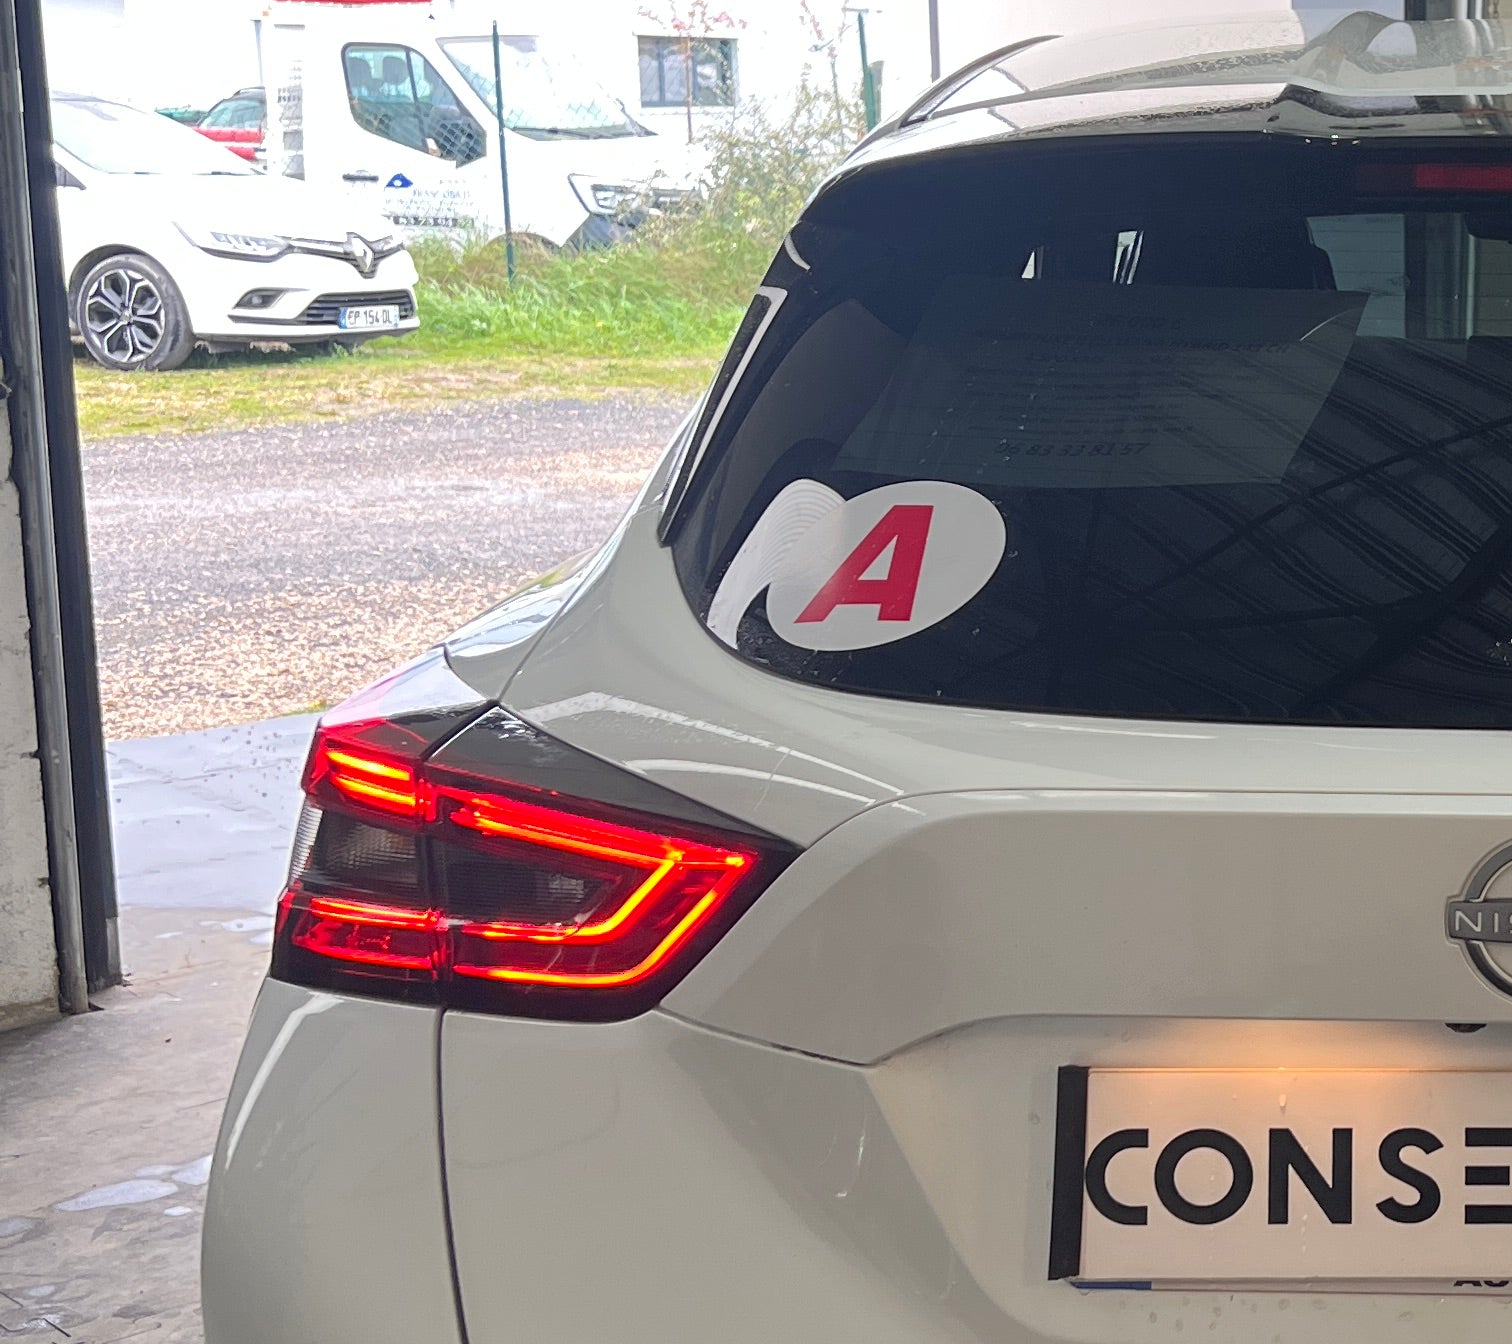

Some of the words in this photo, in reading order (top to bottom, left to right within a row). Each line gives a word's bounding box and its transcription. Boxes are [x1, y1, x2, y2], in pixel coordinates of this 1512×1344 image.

[995, 442, 1025, 455] 06
[1026, 444, 1055, 457] 83
[1056, 444, 1086, 457] 33
[1088, 442, 1116, 457] 81
[1119, 442, 1151, 456] 57
[793, 504, 935, 624] A
